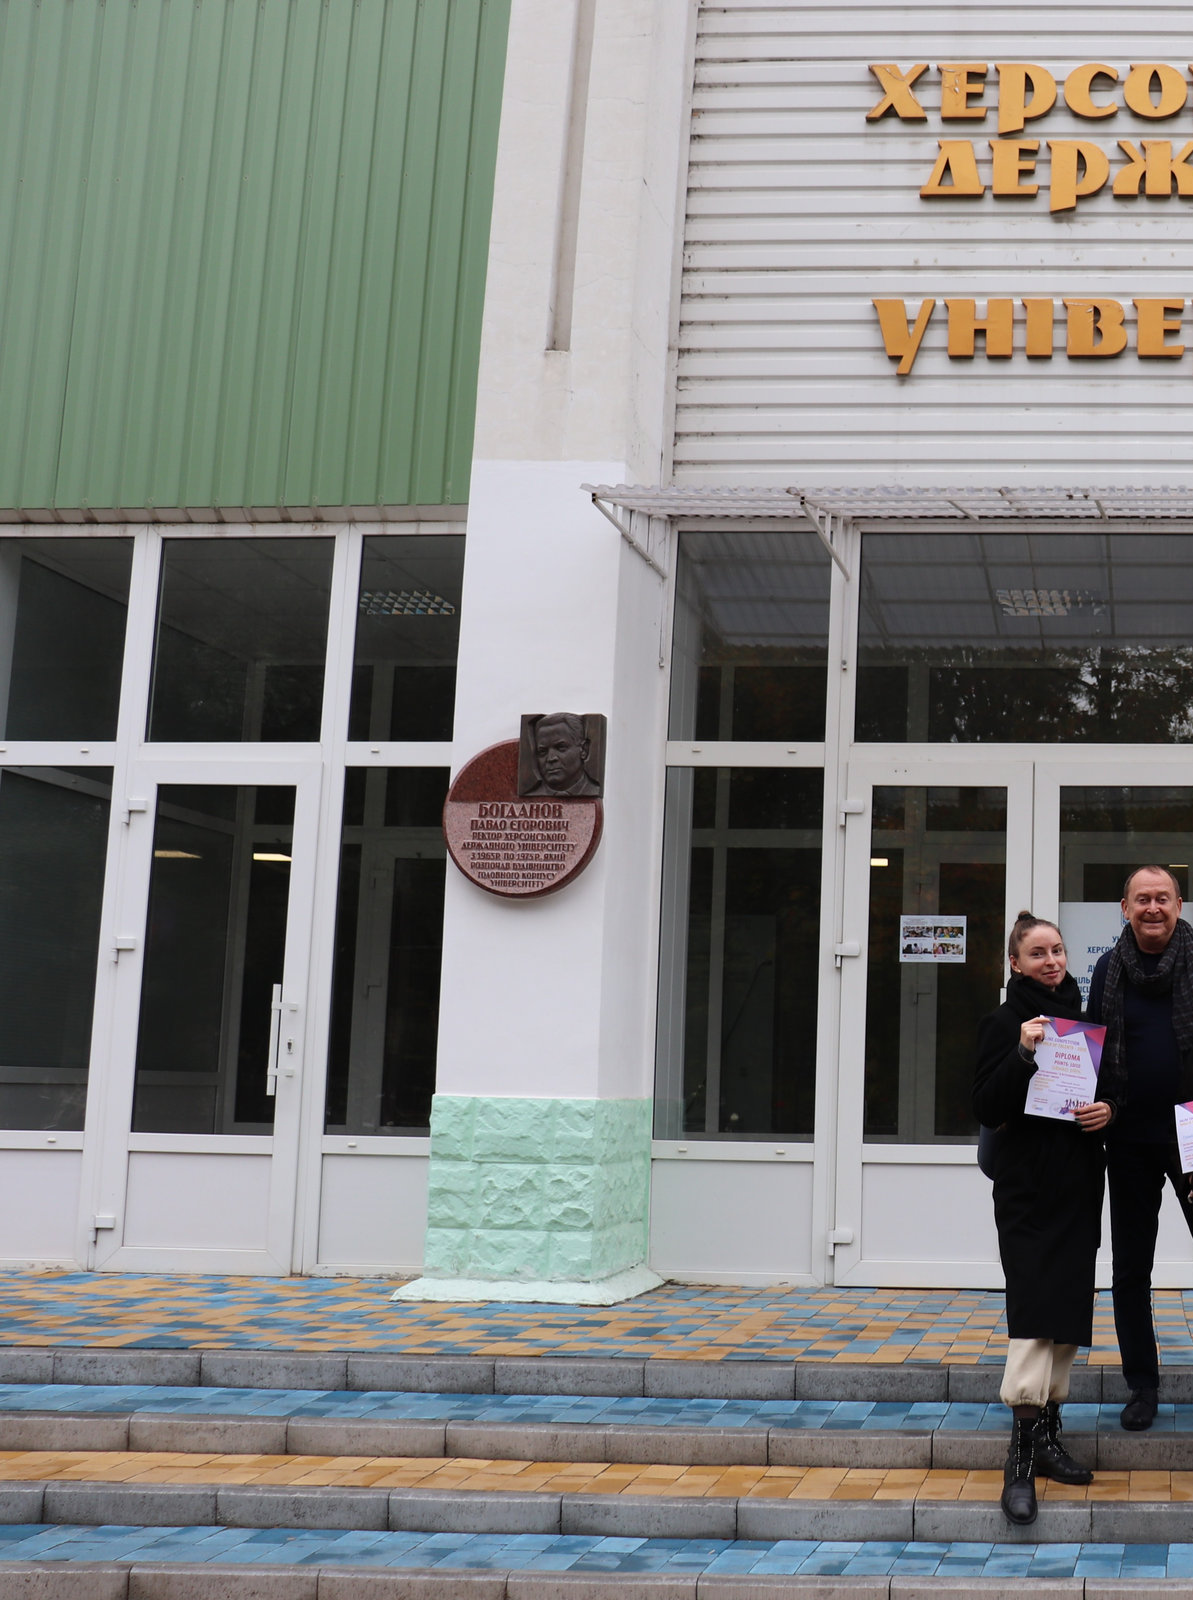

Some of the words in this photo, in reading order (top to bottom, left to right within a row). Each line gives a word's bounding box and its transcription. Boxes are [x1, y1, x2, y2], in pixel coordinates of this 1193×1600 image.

[478, 803, 564, 818] БОГДАНОВ
[470, 820, 507, 830] ПАВЛО
[510, 820, 569, 831] ЄГОРОВИЧ
[472, 832, 502, 840] РЕКТОР
[504, 832, 567, 841] ХЕРСОНСЬКОГО
[461, 842, 515, 850] ДЕРЖАВНОГО
[518, 842, 577, 852] УНІВЕРСИТЕТУ
[544, 853, 566, 861] ЯКИЙ
[470, 862, 510, 870] РОЗПОЧАВ
[512, 862, 566, 870] БУДІВНИЦТВО
[522, 872, 557, 880] КОРПУСУ
[490, 880, 545, 888] УНІВЕРСИТЕТУ
[1055, 1052, 1080, 1060] DIPLOMA
